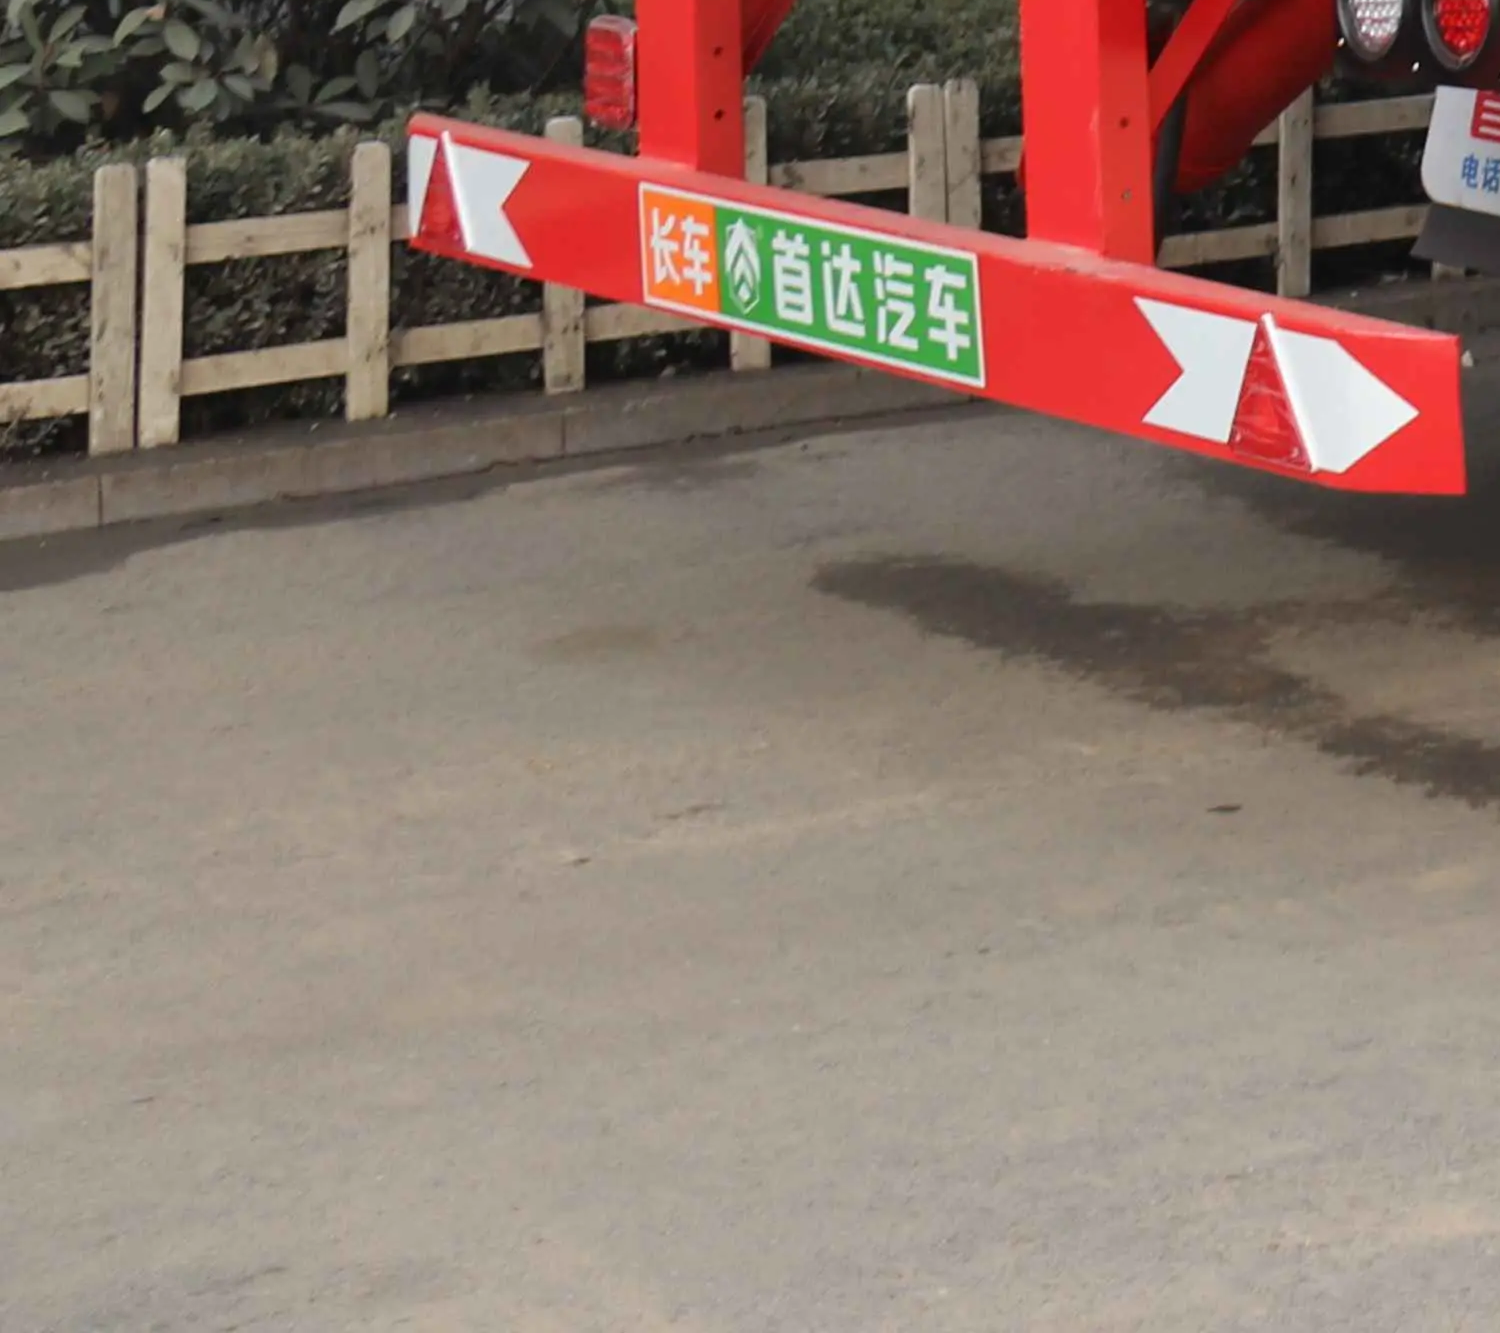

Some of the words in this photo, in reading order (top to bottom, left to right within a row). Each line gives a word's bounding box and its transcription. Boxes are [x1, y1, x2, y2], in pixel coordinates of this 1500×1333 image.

[651, 206, 713, 296] 长车
[771, 228, 972, 361] 首达汽车
